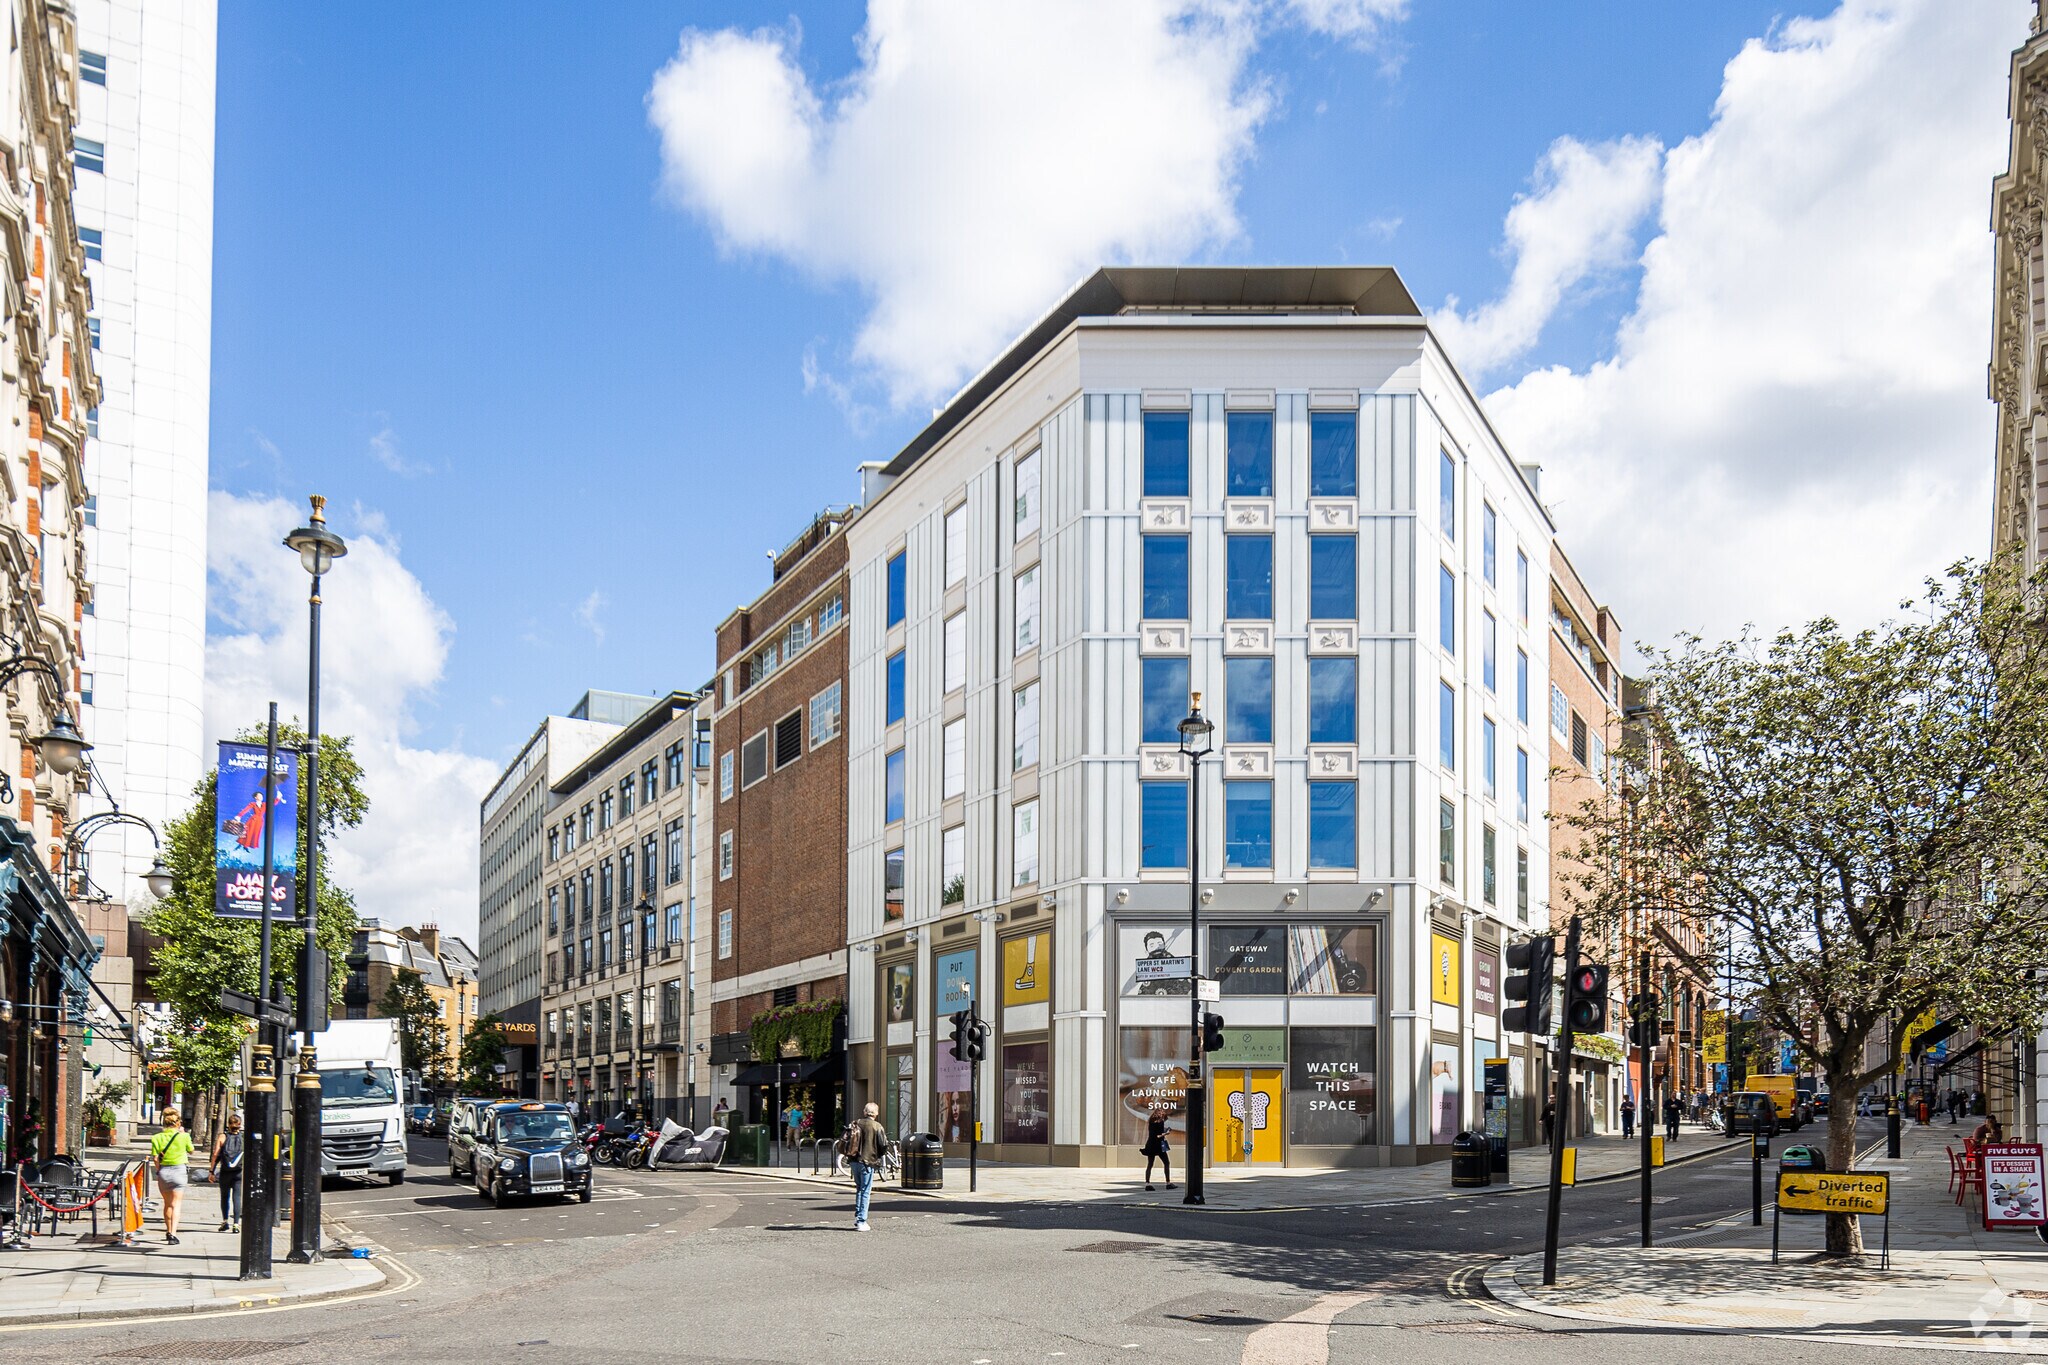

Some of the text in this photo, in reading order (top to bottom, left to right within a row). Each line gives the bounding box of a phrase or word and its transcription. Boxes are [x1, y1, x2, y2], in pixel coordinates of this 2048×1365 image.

[235, 752, 280, 764] SUMMES
[225, 883, 287, 902] POPPNS
[1160, 958, 1185, 966] MARTIN'S
[950, 962, 963, 973] PUT
[1215, 966, 1247, 974] COVENT
[504, 1022, 537, 1032] YARDS
[1017, 1062, 1035, 1071] WE'VE
[1151, 1063, 1175, 1071] NEW
[1306, 1062, 1359, 1073] WATCH
[1015, 1076, 1037, 1085] MISSED
[1149, 1075, 1176, 1084] CAFÉ
[1315, 1081, 1350, 1092] THIS
[1131, 1089, 1186, 1097] LAUNCHIN
[1012, 1103, 1040, 1113] WELCOME
[1148, 1102, 1177, 1110] SOON
[1309, 1100, 1356, 1111] SPACE
[323, 1113, 352, 1121] brakes
[1018, 1118, 1034, 1127] BACK
[2010, 1147, 2037, 1155] GUYS
[1818, 1179, 1883, 1193] Diverted
[1826, 1196, 1874, 1208] traffic
